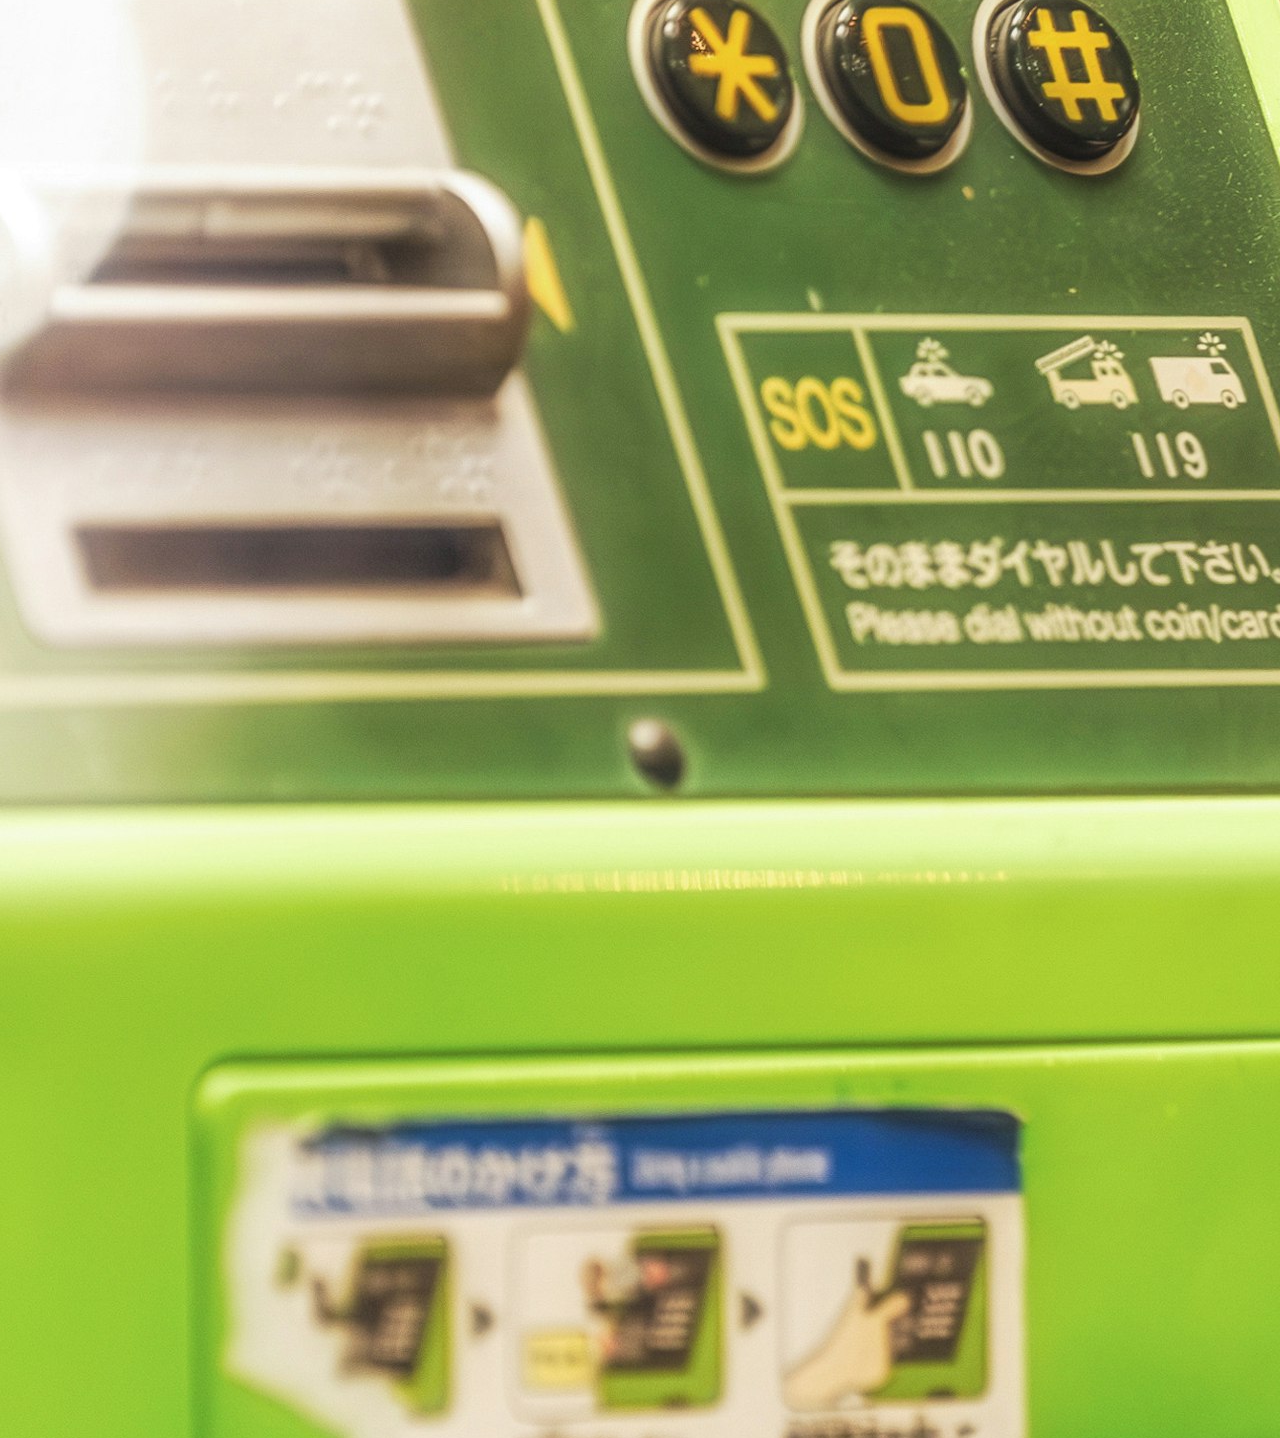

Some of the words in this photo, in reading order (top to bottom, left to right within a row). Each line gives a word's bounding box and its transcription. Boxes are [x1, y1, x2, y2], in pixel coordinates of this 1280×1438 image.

[860, 5, 951, 126] 0
[761, 377, 877, 451] SOS
[921, 428, 1006, 480] 110
[1130, 430, 1209, 480] 119
[1023, 604, 1143, 642] without
